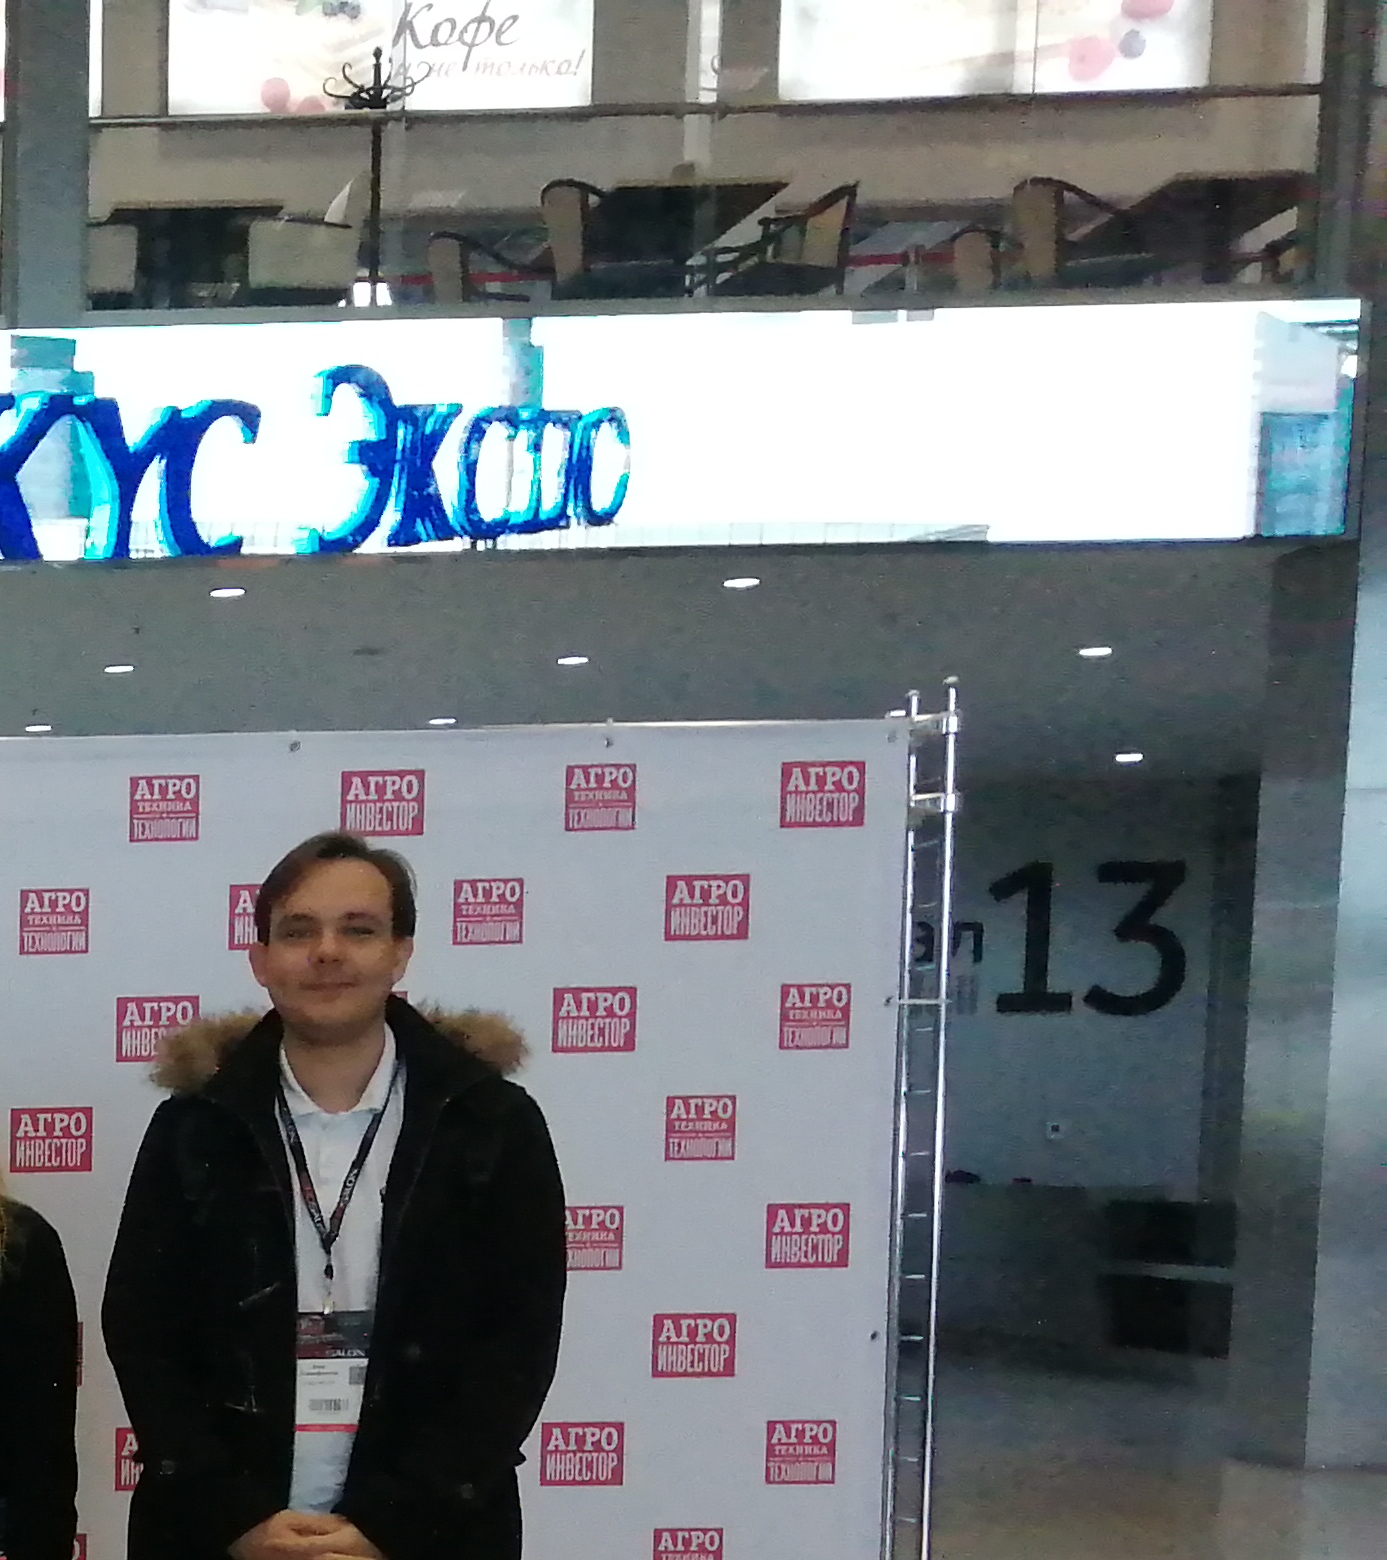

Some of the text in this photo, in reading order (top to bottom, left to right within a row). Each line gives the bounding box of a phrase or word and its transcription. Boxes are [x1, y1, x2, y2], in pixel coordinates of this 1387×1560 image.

[392, 0, 521, 72] Кофе
[429, 61, 457, 78] не
[475, 49, 586, 77] только!
[135, 779, 195, 800] АГРО
[347, 774, 419, 800] АГРО
[571, 767, 632, 789] АГРО
[787, 766, 860, 792] АГРО
[346, 801, 417, 833] ИНВЕСТОР
[786, 793, 858, 825] ИНВЕСТОР
[25, 892, 84, 913] АГРО
[458, 882, 519, 903] АГРО
[671, 879, 744, 905] АГРО
[670, 906, 742, 938] ИНВЕСТОР
[988, 859, 1188, 1017] 13
[559, 991, 631, 1017] АГРО
[784, 987, 847, 1008] АГРО
[123, 1000, 193, 1026] АГРО
[558, 1018, 629, 1050] ИНВЕСТОР
[670, 1099, 731, 1120] АГРО
[16, 1112, 87, 1138] АГРО
[15, 1139, 85, 1171] ИНВЕСТОР
[772, 1208, 845, 1234] АГРО
[771, 1235, 843, 1266] ИНВЕСТОР
[658, 1318, 731, 1343] АГРО
[657, 1344, 729, 1375] ИНВЕСТОР
[546, 1426, 619, 1451] АГРО
[770, 1423, 832, 1444] АГРО
[545, 1452, 617, 1483] ИНВЕСТОР
[657, 1532, 719, 1552] АГРО
